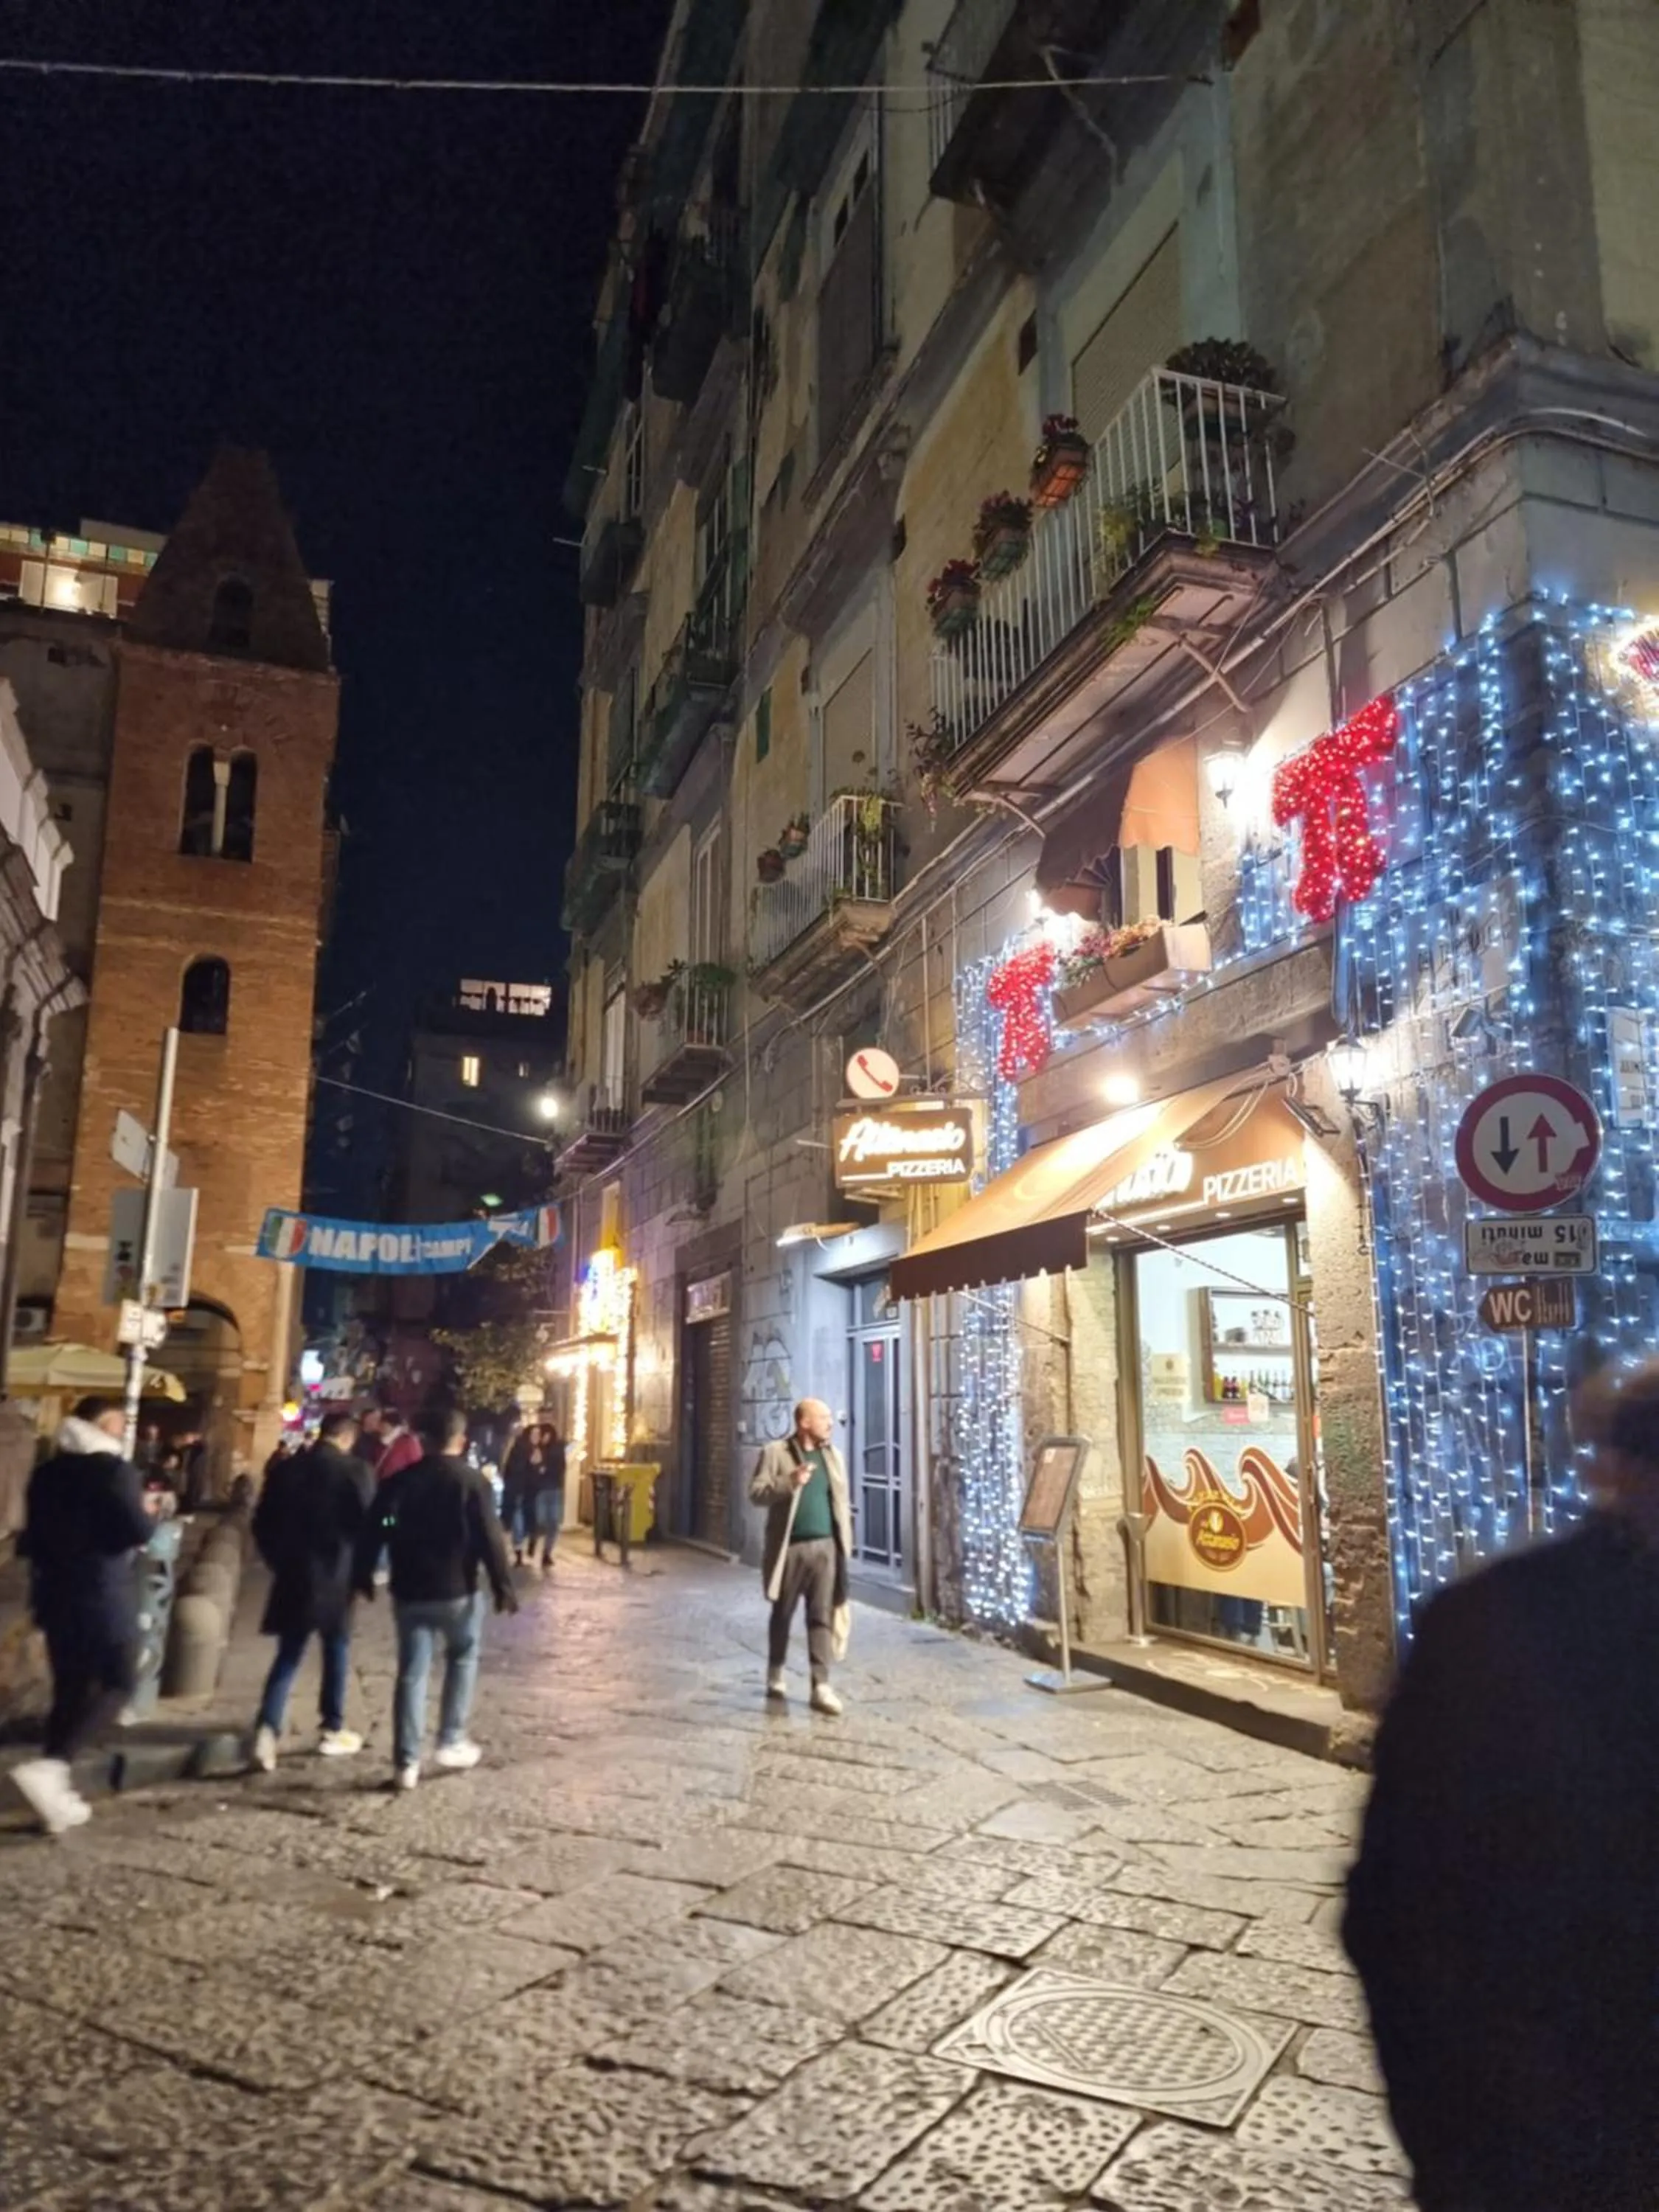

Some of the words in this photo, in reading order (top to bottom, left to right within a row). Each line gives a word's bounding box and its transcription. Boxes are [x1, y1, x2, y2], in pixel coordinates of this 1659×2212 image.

[887, 1158, 966, 1178] PIZZERIA
[1203, 1155, 1302, 1204] PIZZERIA
[1481, 1225, 1543, 1245] minuti
[1554, 1225, 1576, 1244] 15
[1489, 1289, 1532, 1325] WC
